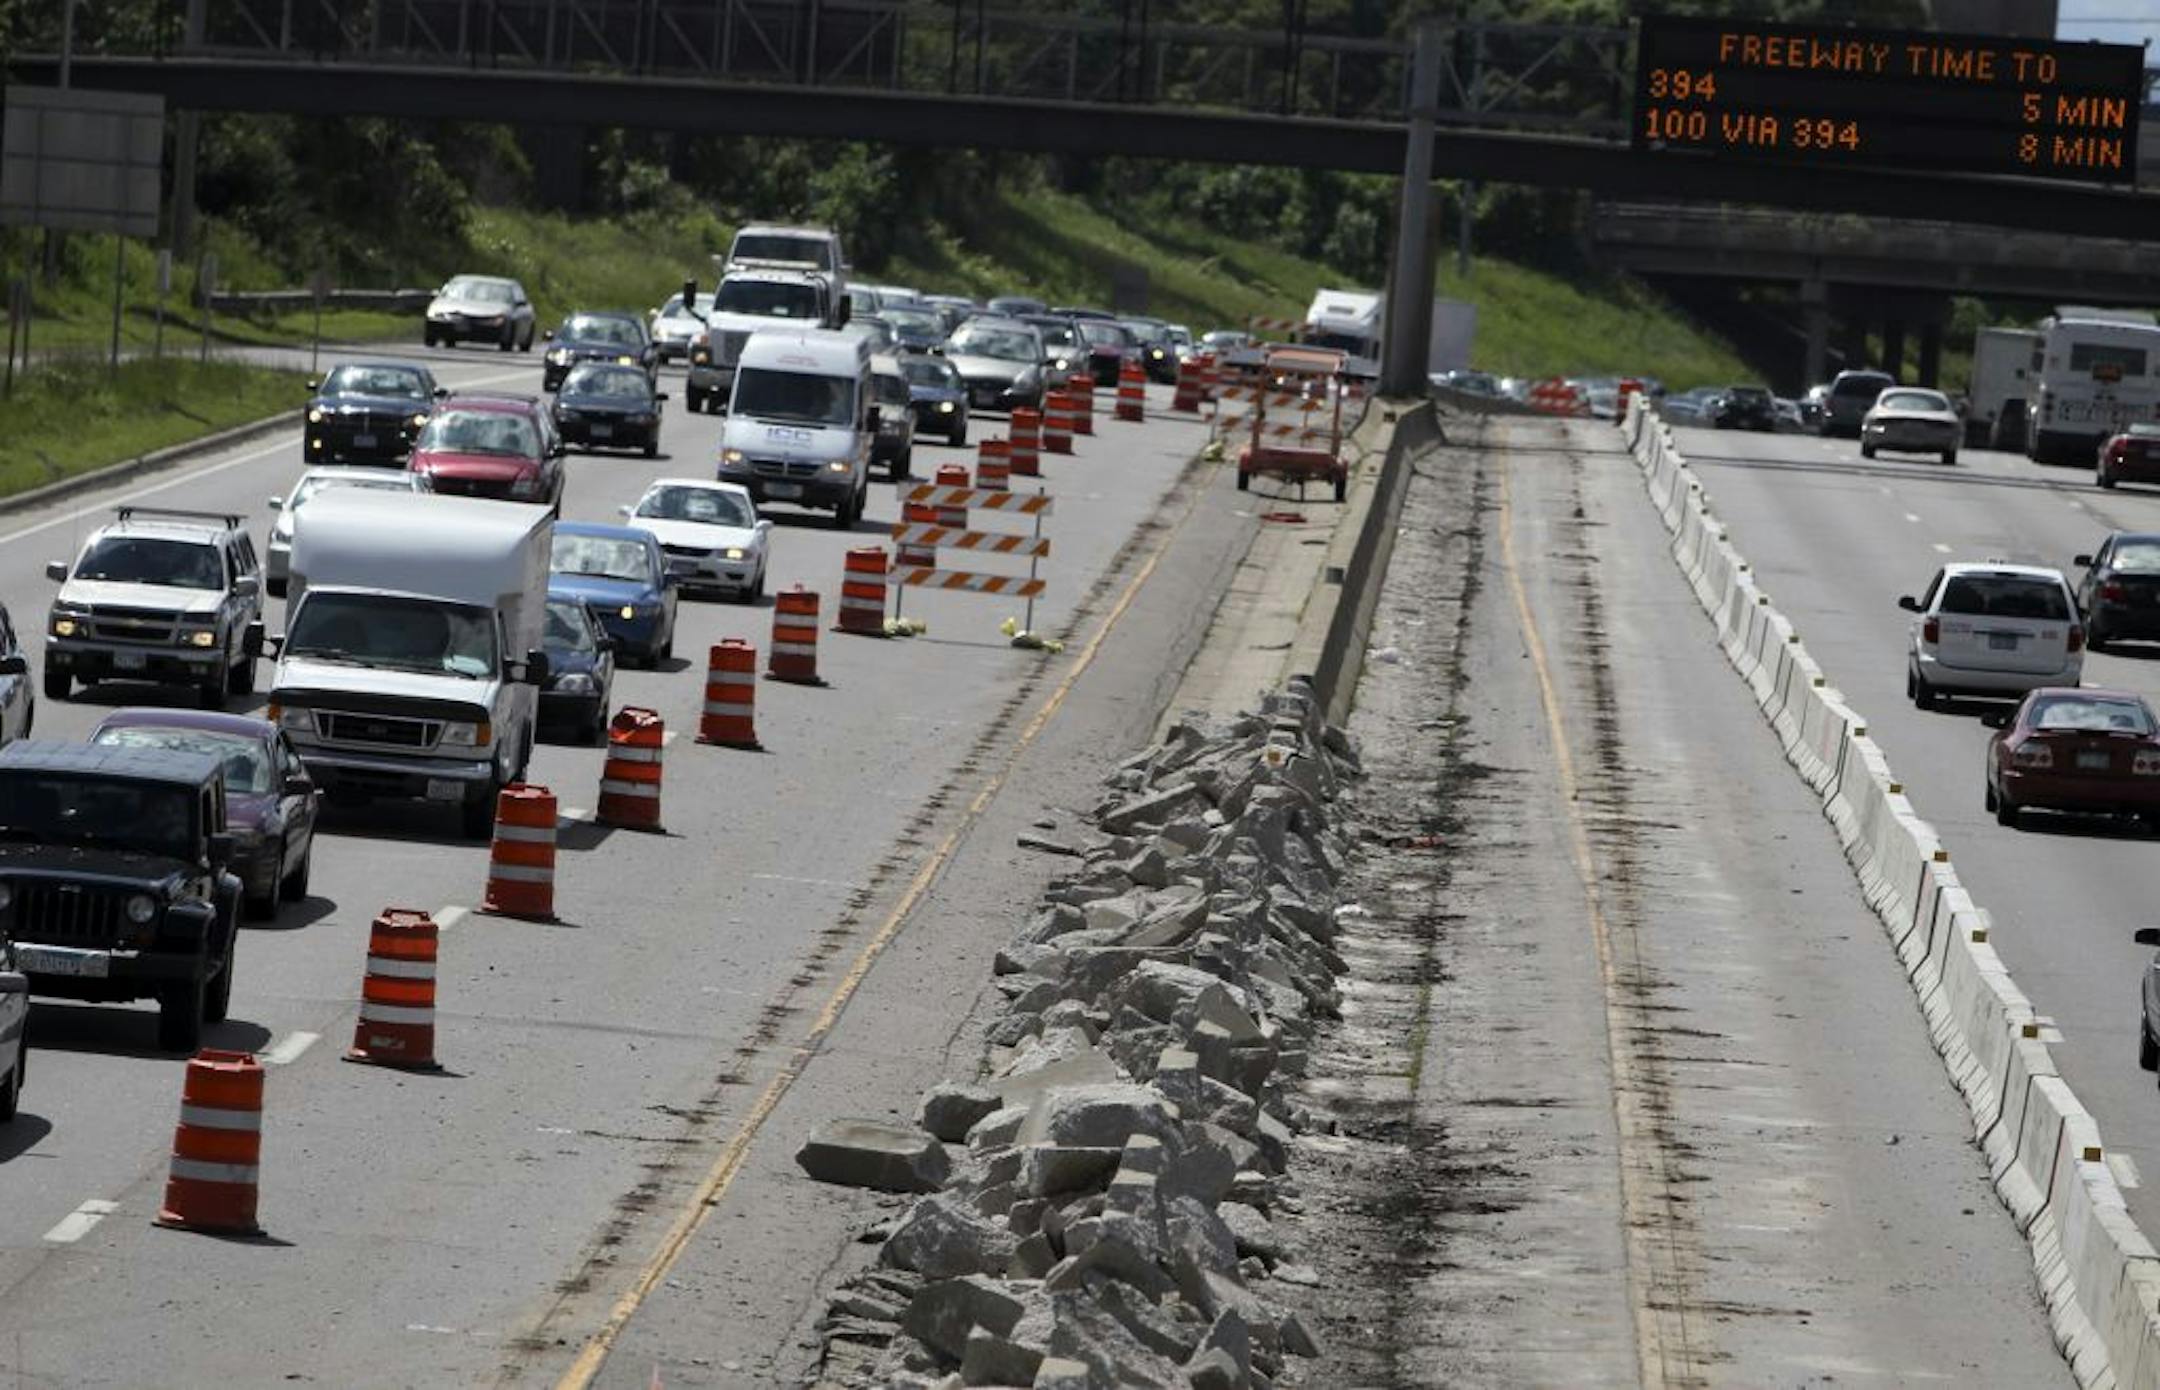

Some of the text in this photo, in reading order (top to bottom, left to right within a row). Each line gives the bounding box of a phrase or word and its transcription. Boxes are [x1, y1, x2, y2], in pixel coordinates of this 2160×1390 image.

[1719, 33, 2056, 84] FREEWAY TIME TO
[1649, 68, 2126, 128] 394 5 MIN
[1646, 106, 2123, 169] 100 VIA 394 8 MIN
